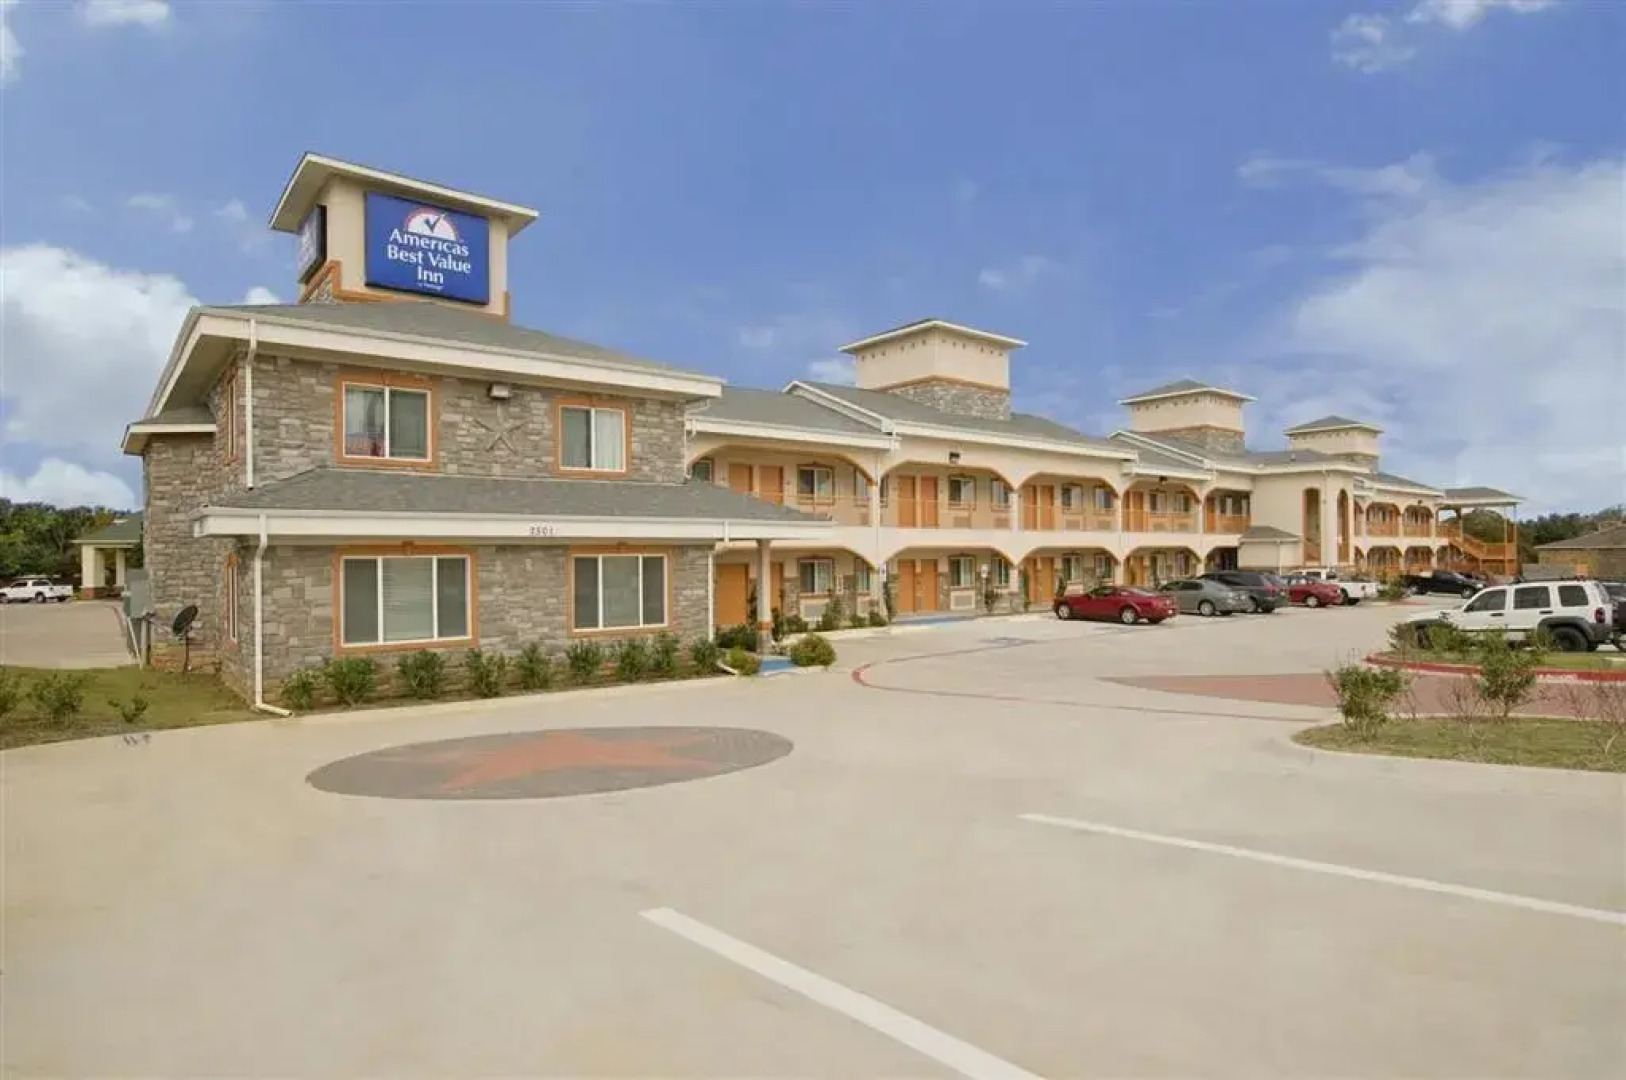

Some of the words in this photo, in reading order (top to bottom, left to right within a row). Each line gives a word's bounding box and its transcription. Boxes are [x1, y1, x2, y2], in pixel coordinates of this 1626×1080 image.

[389, 228, 470, 257] Americas
[387, 244, 423, 265] Best
[428, 253, 471, 274] Value
[417, 266, 444, 284] Inn
